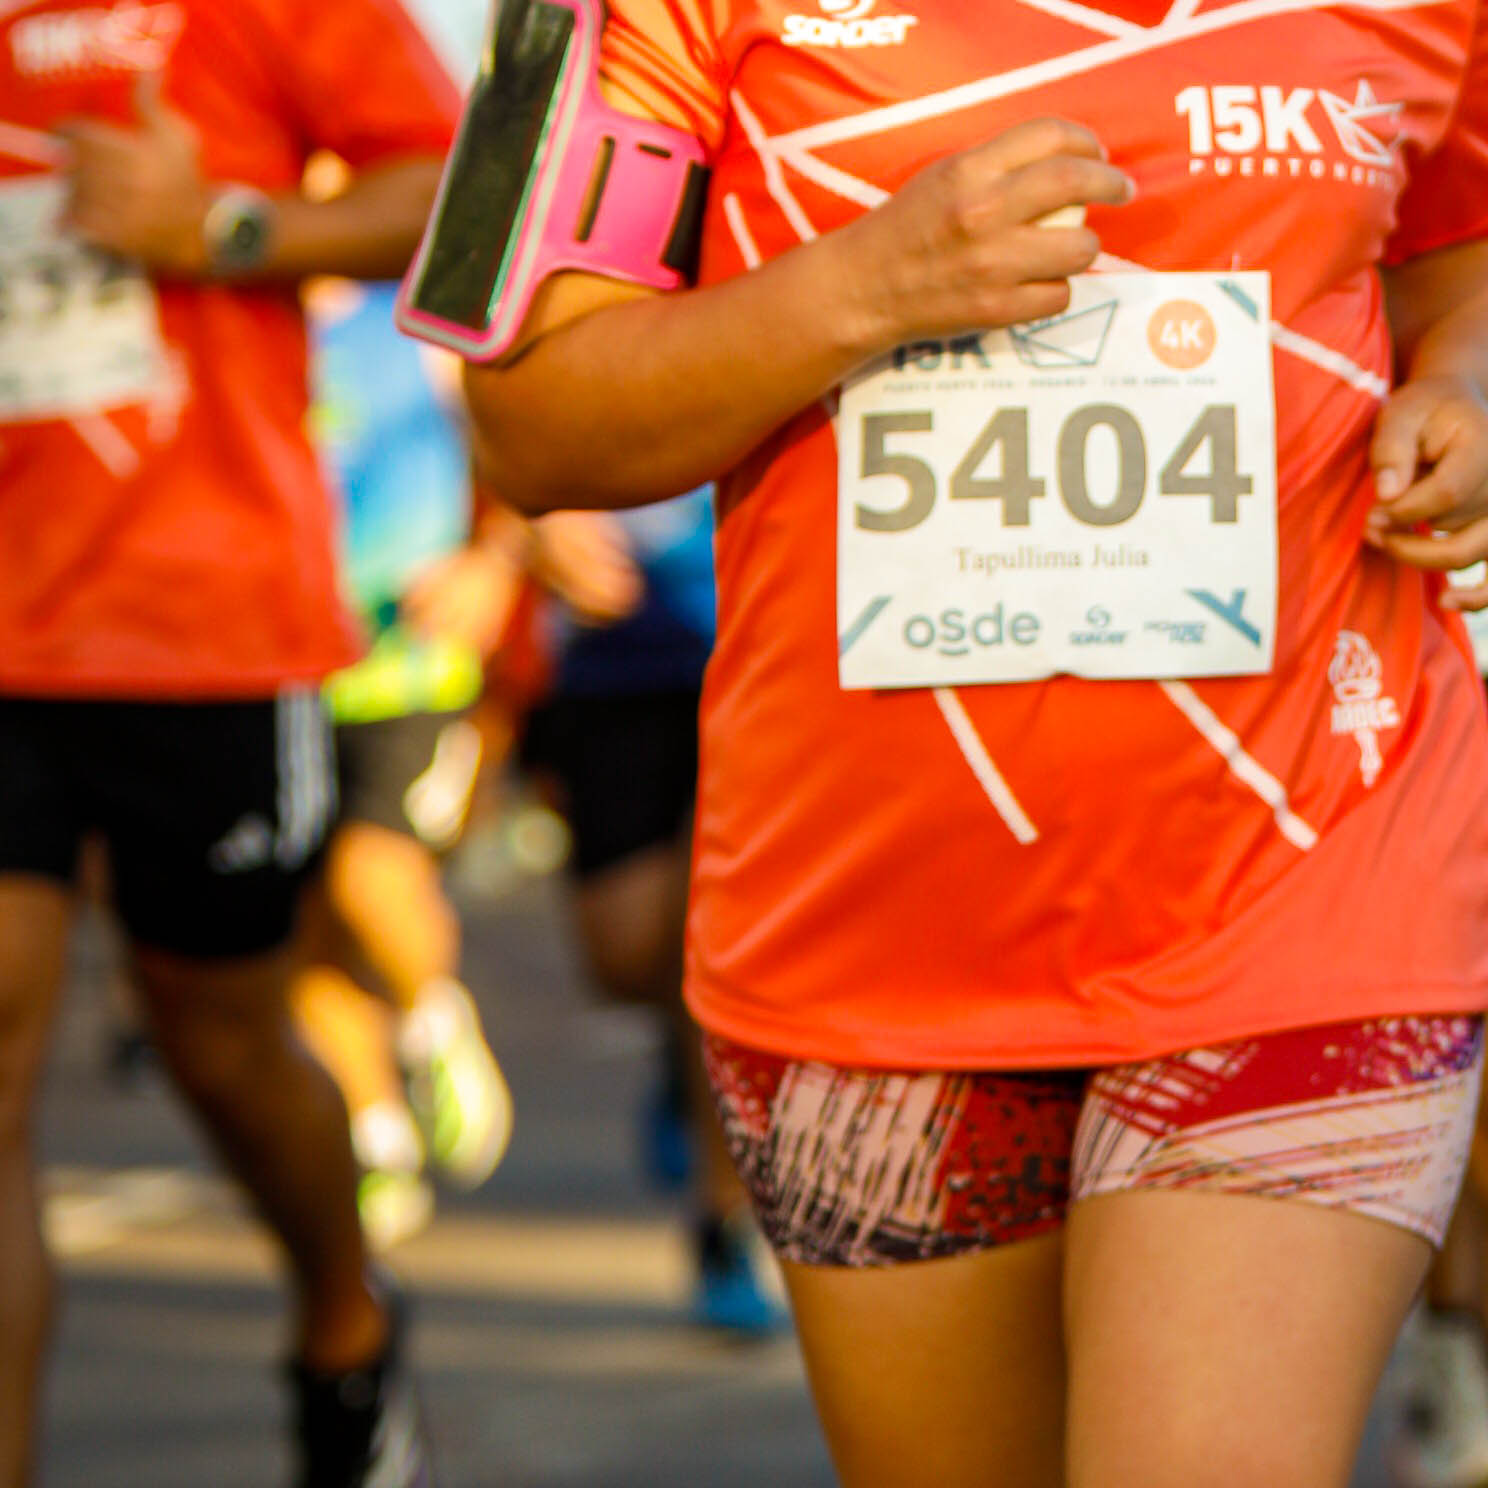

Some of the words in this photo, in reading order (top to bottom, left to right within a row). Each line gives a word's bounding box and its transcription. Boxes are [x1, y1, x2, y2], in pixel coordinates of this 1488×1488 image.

[1175, 85, 1324, 155] 15K
[1189, 157, 1325, 179] PUERTO
[1160, 319, 1203, 350] 4K
[855, 403, 1254, 534] 5404
[955, 546, 1082, 577] Tapullima
[1091, 544, 1149, 568] Julia
[904, 603, 1040, 654] osde
